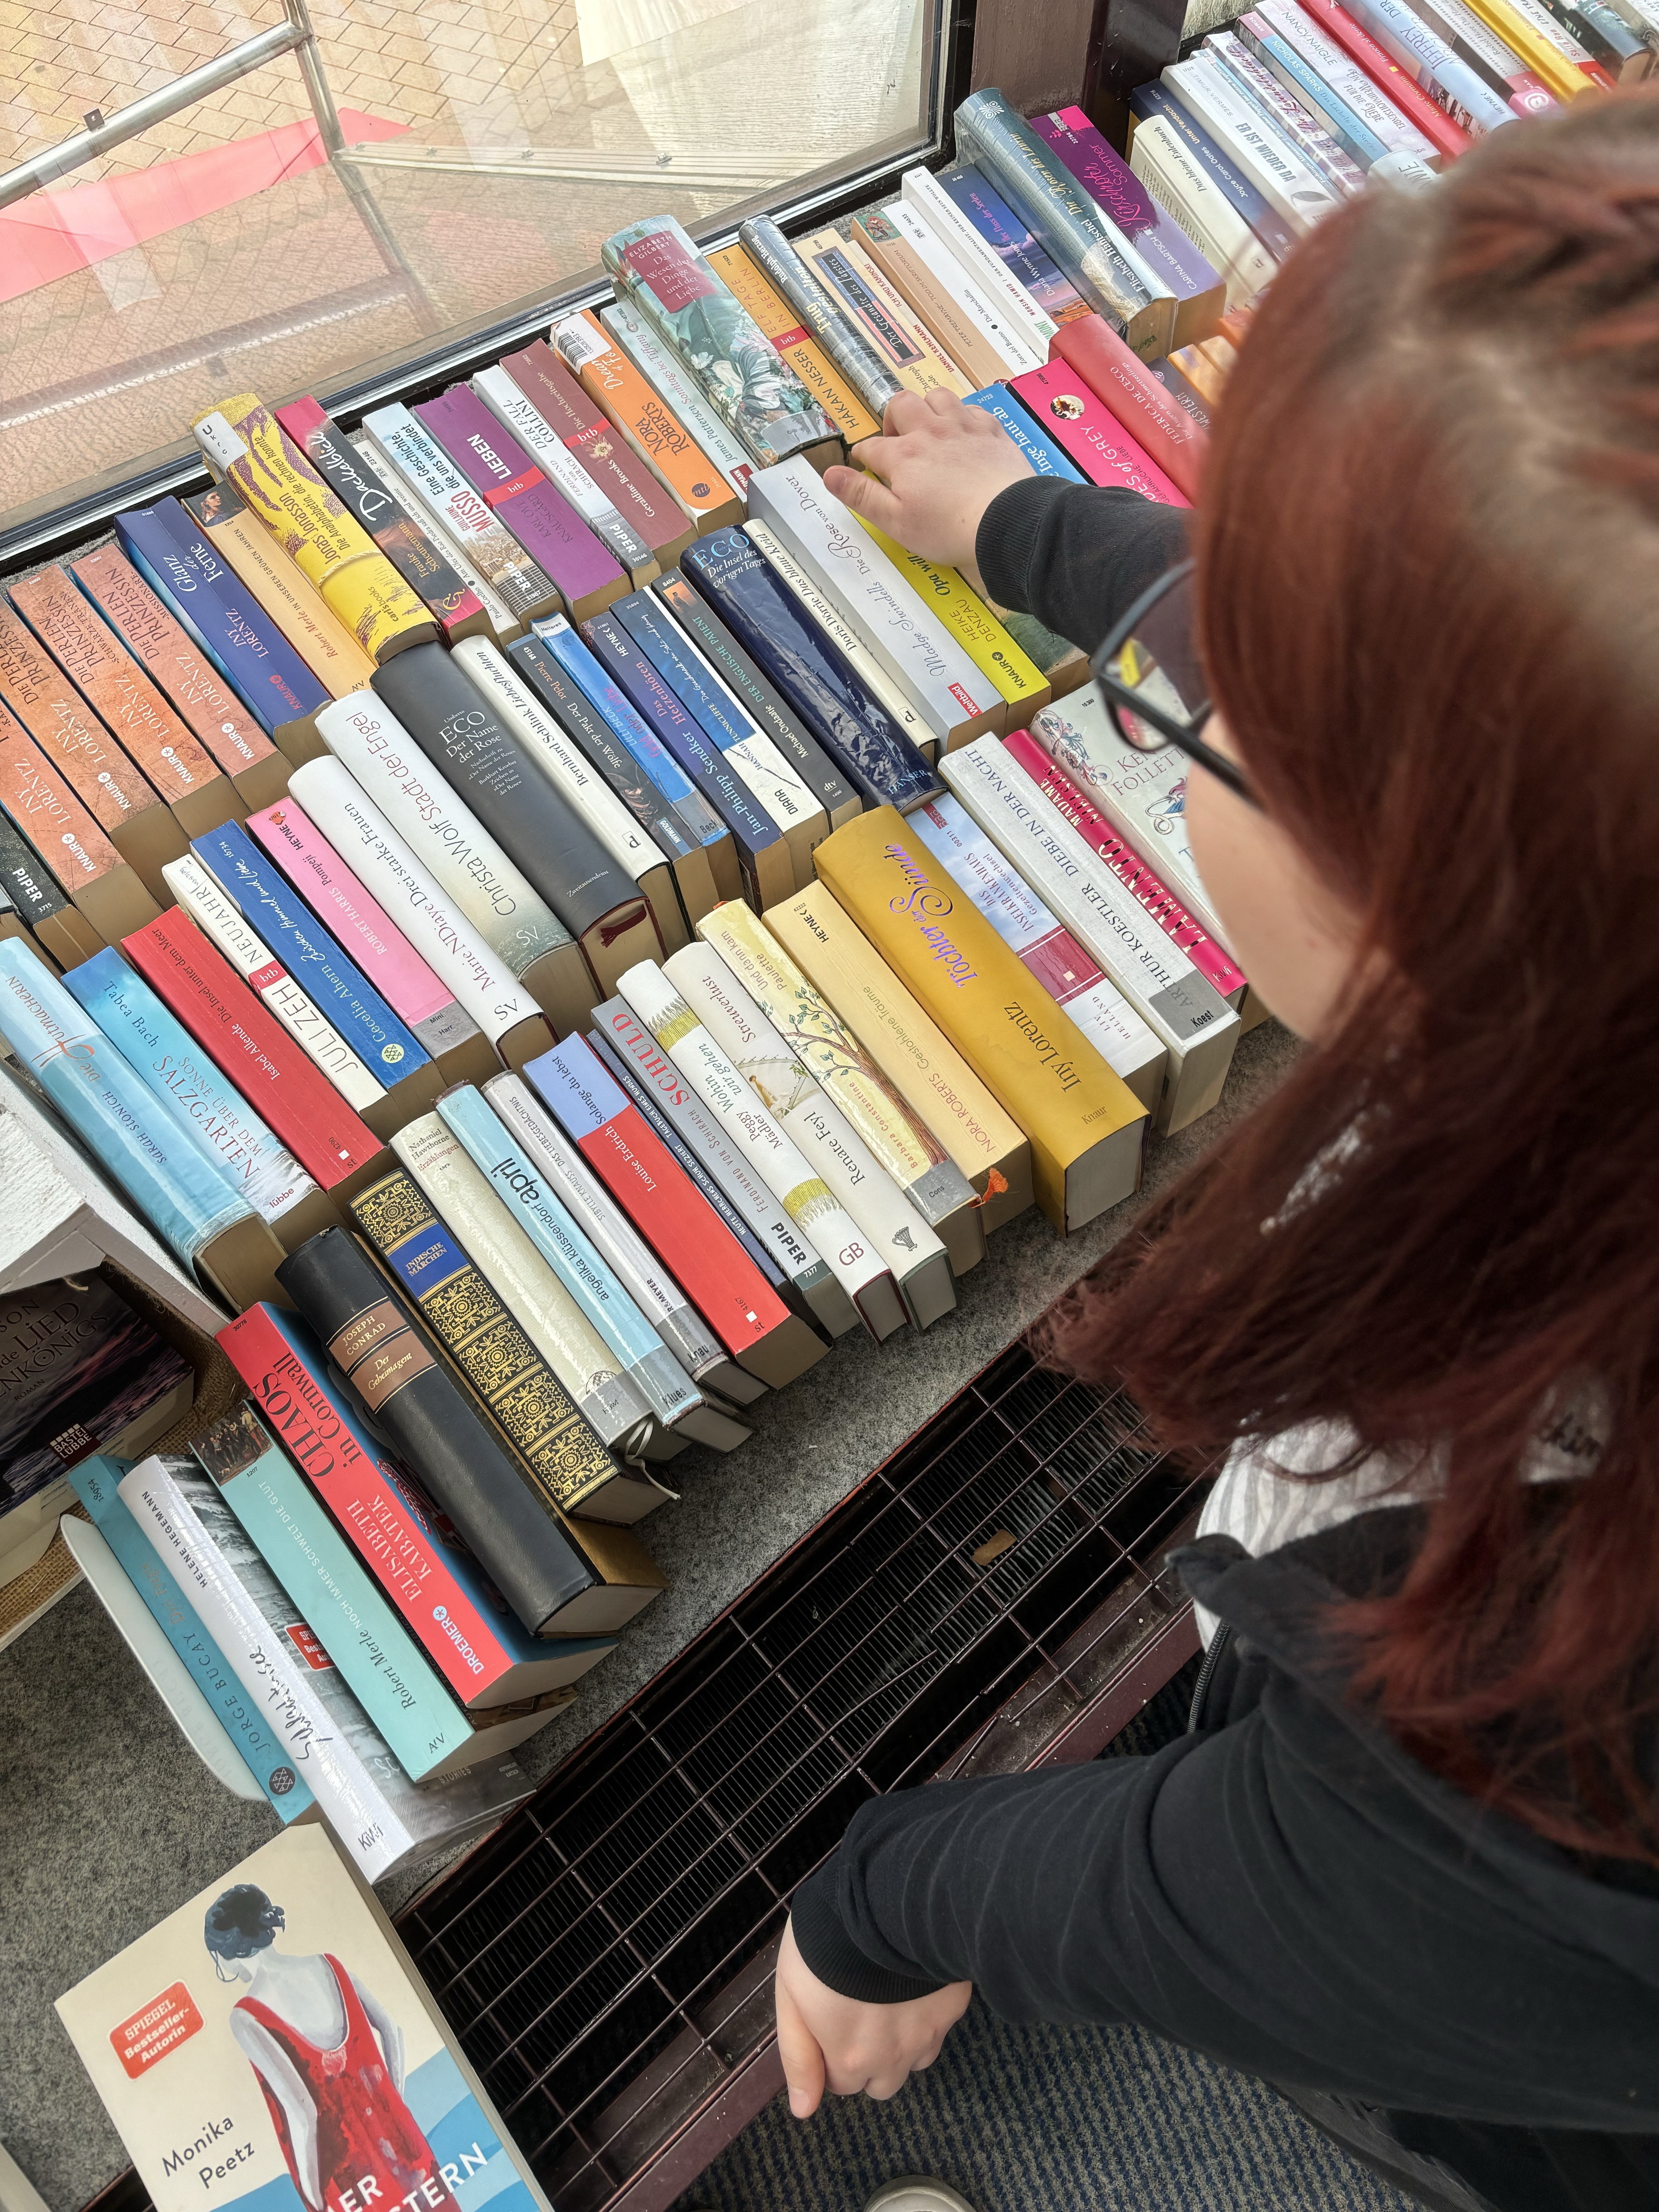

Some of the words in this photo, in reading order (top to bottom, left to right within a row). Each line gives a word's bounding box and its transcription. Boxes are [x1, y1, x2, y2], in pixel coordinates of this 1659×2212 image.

[1248, 15, 1265, 33] ROMAN
[1400, 23, 1447, 69] JEFFREY
[1271, 39, 1300, 70] NICHOLAS
[1298, 67, 1323, 93] SPARKS
[1151, 88, 1161, 100] 62216
[1163, 102, 1187, 129] Verdacht
[1235, 120, 1252, 135] ER
[1183, 127, 1200, 144] Unter
[1243, 129, 1264, 148] IST
[1255, 142, 1287, 173] WIEDER
[1278, 168, 1296, 184] DA
[629, 233, 671, 257] ELIZABETH
[638, 240, 670, 259] GILBERT
[749, 234, 770, 258] Herzog
[1007, 239, 1026, 259] Jones
[1080, 216, 1117, 258] Häntschel
[1150, 235, 1177, 266] BARTSCH
[764, 255, 789, 284] Rudolph
[1020, 254, 1041, 278] Wynne
[1110, 254, 1146, 294] Elisabeth
[1173, 264, 1197, 291] CARINA
[1037, 276, 1056, 297] Diana
[997, 330, 1012, 347] Buono
[1008, 345, 1018, 354] del
[792, 347, 828, 388] NESSER
[1014, 352, 1027, 366] Zora
[820, 386, 860, 430] HÅKAN
[252, 434, 277, 460] konnte
[362, 450, 377, 466] 23146
[387, 429, 431, 480] Geschichte,
[400, 421, 438, 463] verbindet
[467, 431, 512, 481] LIEBEN
[270, 456, 297, 486] rechnen
[306, 419, 396, 526] Dackelblick
[423, 474, 445, 497] Eine
[432, 459, 449, 477] uns
[442, 474, 460, 491] die
[291, 482, 306, 496] die
[276, 490, 319, 538] Jonasson
[299, 492, 343, 541] Analphabetin,
[445, 504, 471, 532] GUILLAUME
[450, 488, 495, 534] MUSSO
[186, 540, 224, 583] Ferne
[309, 533, 341, 567] Jonas
[335, 536, 351, 551] Die
[160, 551, 198, 596] Glanz
[180, 553, 199, 574] der
[948, 607, 980, 643] HEIKE
[955, 596, 997, 643] DENZAU
[606, 630, 629, 657] HEYNE
[474, 647, 529, 712] Liebesfluchten
[998, 658, 1027, 690] KNAUR
[951, 683, 979, 716] Weltbild
[345, 707, 392, 756] Engel
[438, 705, 487, 747] ECO
[520, 706, 556, 745] Schlink
[763, 702, 791, 735] Ondaatje
[445, 738, 467, 758] Der
[465, 718, 499, 747] Name
[456, 746, 476, 763] der
[473, 729, 502, 754] Rose
[679, 729, 718, 776] Sendker
[785, 732, 809, 759] Michael
[376, 747, 410, 782] der
[548, 741, 589, 788] Bernhard
[1111, 740, 1185, 801] FOLLETT
[13, 756, 71, 825] LORENTZ
[14, 783, 43, 815] INY
[398, 775, 442, 823] Stadt
[712, 771, 768, 838] Jan-Philipp
[340, 801, 378, 845] Frauen
[428, 814, 474, 865] Wolf
[946, 829, 962, 847] 00311
[68, 840, 96, 873] KNAUR
[218, 840, 235, 859] 16734
[370, 840, 407, 880] starke
[12, 866, 43, 903] PIPER
[302, 852, 333, 887] Pompeji
[462, 855, 517, 919] Christa
[327, 885, 359, 922] HARRIS
[397, 874, 428, 907] Drei
[194, 886, 263, 965] NEUJAHR
[803, 913, 829, 943] HEYNE
[1080, 882, 1143, 952] KOESTLER
[150, 926, 172, 951] Meer
[354, 917, 388, 955] ROBERT
[166, 947, 187, 969] dem
[180, 965, 203, 989] unter
[319, 963, 353, 1002] Ahern
[1138, 950, 1192, 1010] ARTHUR
[197, 985, 219, 1008] Insel
[214, 1003, 232, 1022] Die
[271, 982, 319, 1032] ZEH
[699, 973, 757, 1044] Streuverlust
[347, 999, 386, 1043] Cecelia
[1001, 998, 1060, 1065] Lorentz
[308, 1026, 359, 1079] JULI
[550, 1055, 571, 1079] lebst
[609, 1009, 690, 1108] SCHULD
[565, 1075, 580, 1092] du
[622, 1074, 641, 1096] HUNDES
[1047, 1056, 1084, 1093] Iny
[575, 1087, 608, 1125] Solange
[637, 1094, 652, 1111] EINES
[928, 1071, 969, 1119] ROBERTS
[151, 1053, 259, 1181] SALZGARTEN
[508, 1095, 555, 1154] LIEBESGEDÄCHTNIS
[648, 1109, 673, 1139] TAGEBUCH
[803, 1109, 833, 1141] Feyl
[963, 1116, 995, 1153] NORA
[551, 1152, 565, 1166] DAS
[603, 1125, 634, 1161] Erdrich
[824, 1137, 866, 1185] Renate
[489, 1151, 545, 1211] april
[564, 1169, 587, 1196] KNAUSS
[629, 1158, 657, 1192] Louise
[583, 1195, 606, 1221] SIBYLLE
[531, 1201, 579, 1260] klüssendorf
[770, 1221, 807, 1265] PIPER
[572, 1256, 611, 1303] angelika
[803, 1264, 819, 1278] 7377
[12, 1302, 79, 1351] LIED
[340, 1314, 379, 1346] JOSEPH
[343, 1320, 388, 1356] CONRAD
[14, 1378, 45, 1401] ROMAN
[271, 1350, 345, 1442] Cornwall
[53, 1427, 86, 1453] BASTEI
[250, 1369, 339, 1481] CHAOS
[59, 1434, 93, 1460] LÜBBE
[332, 1436, 362, 1468] in
[86, 1477, 106, 1503] 18954
[258, 1479, 279, 1505] GLUT
[141, 1490, 182, 1547] HEGEMANN
[275, 1504, 291, 1523] DIE
[287, 1522, 321, 1566] SCHWELT
[345, 1498, 423, 1602] ELISABETH
[366, 1493, 433, 1580] KABATEK
[178, 1547, 209, 1588] HELENE
[316, 1565, 343, 1600] IMMER
[339, 1599, 363, 1628] NOCH
[182, 1629, 227, 1691] BUCAY
[354, 1628, 388, 1668] Merle
[440, 1616, 485, 1674] DROEMER
[380, 1664, 417, 1710] Robert
[224, 1694, 270, 1753] JORGE
[124, 1998, 176, 2042] SPIEGEL
[124, 2007, 189, 2061] Bestseller-
[139, 2025, 186, 2064] Autorin
[161, 2114, 234, 2178] Monika
[199, 2141, 255, 2190] Peetz
